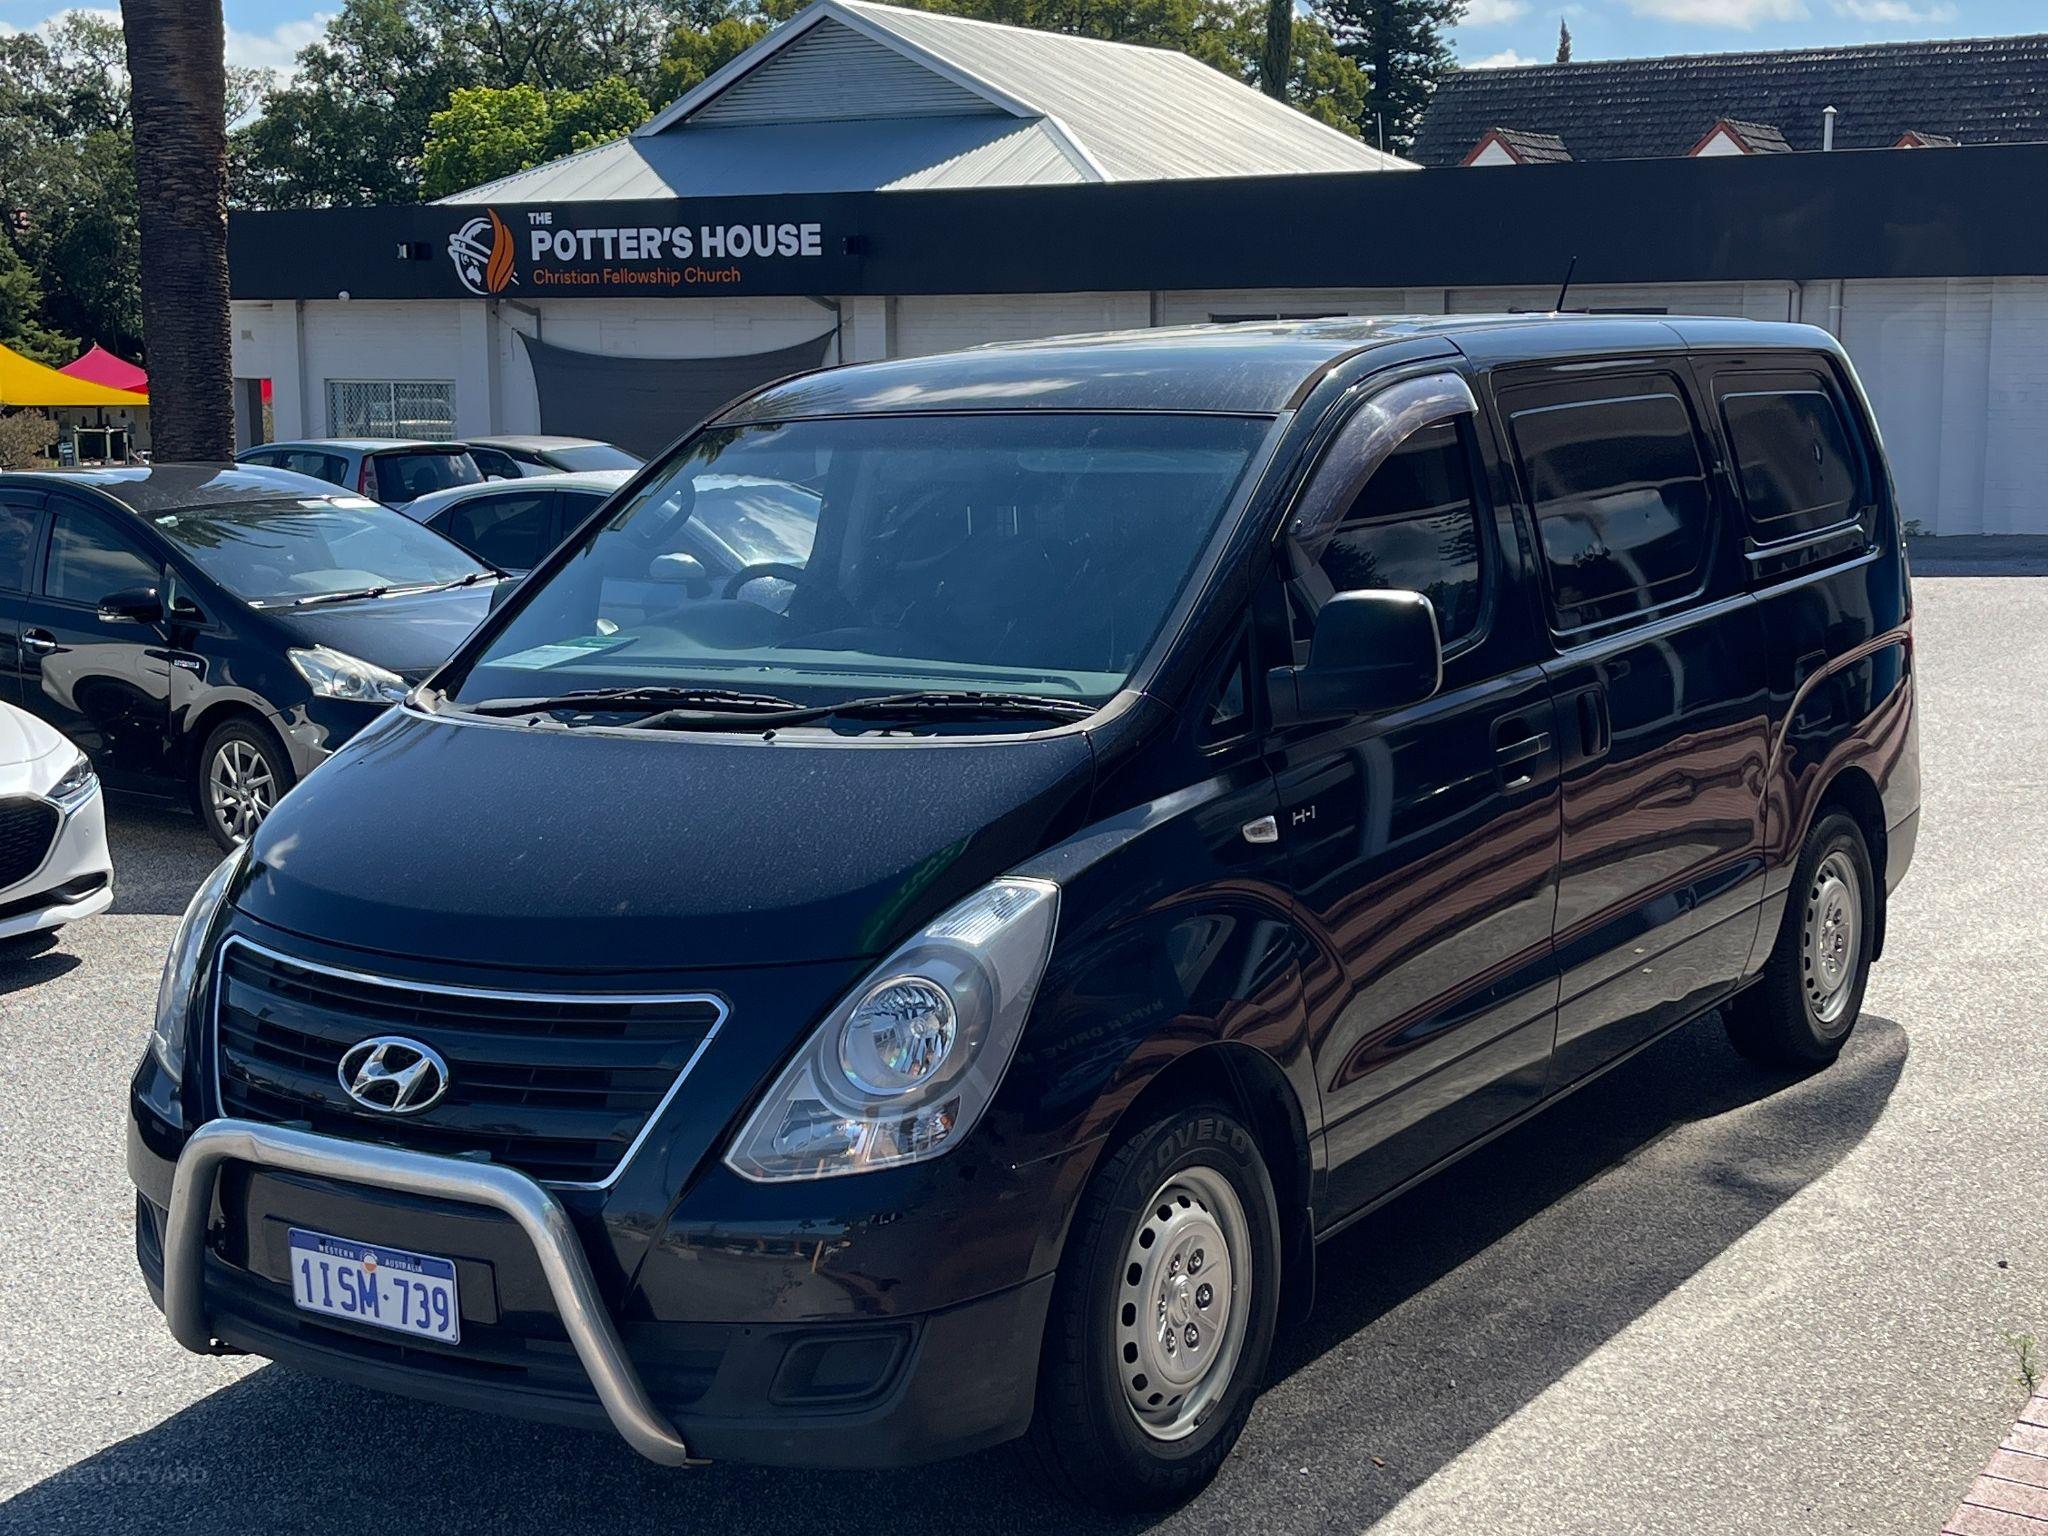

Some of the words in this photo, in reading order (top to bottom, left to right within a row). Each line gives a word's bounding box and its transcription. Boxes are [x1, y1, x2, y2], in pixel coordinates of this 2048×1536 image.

[528, 212, 553, 225] THE
[530, 226, 694, 262] POTTER'S
[701, 223, 822, 258] HOUSE
[533, 267, 599, 285] Christian
[603, 265, 681, 287] Fellowship
[684, 266, 741, 284] Church
[318, 1244, 355, 1259] WESTERN
[384, 1258, 423, 1273] AUSTRALIA
